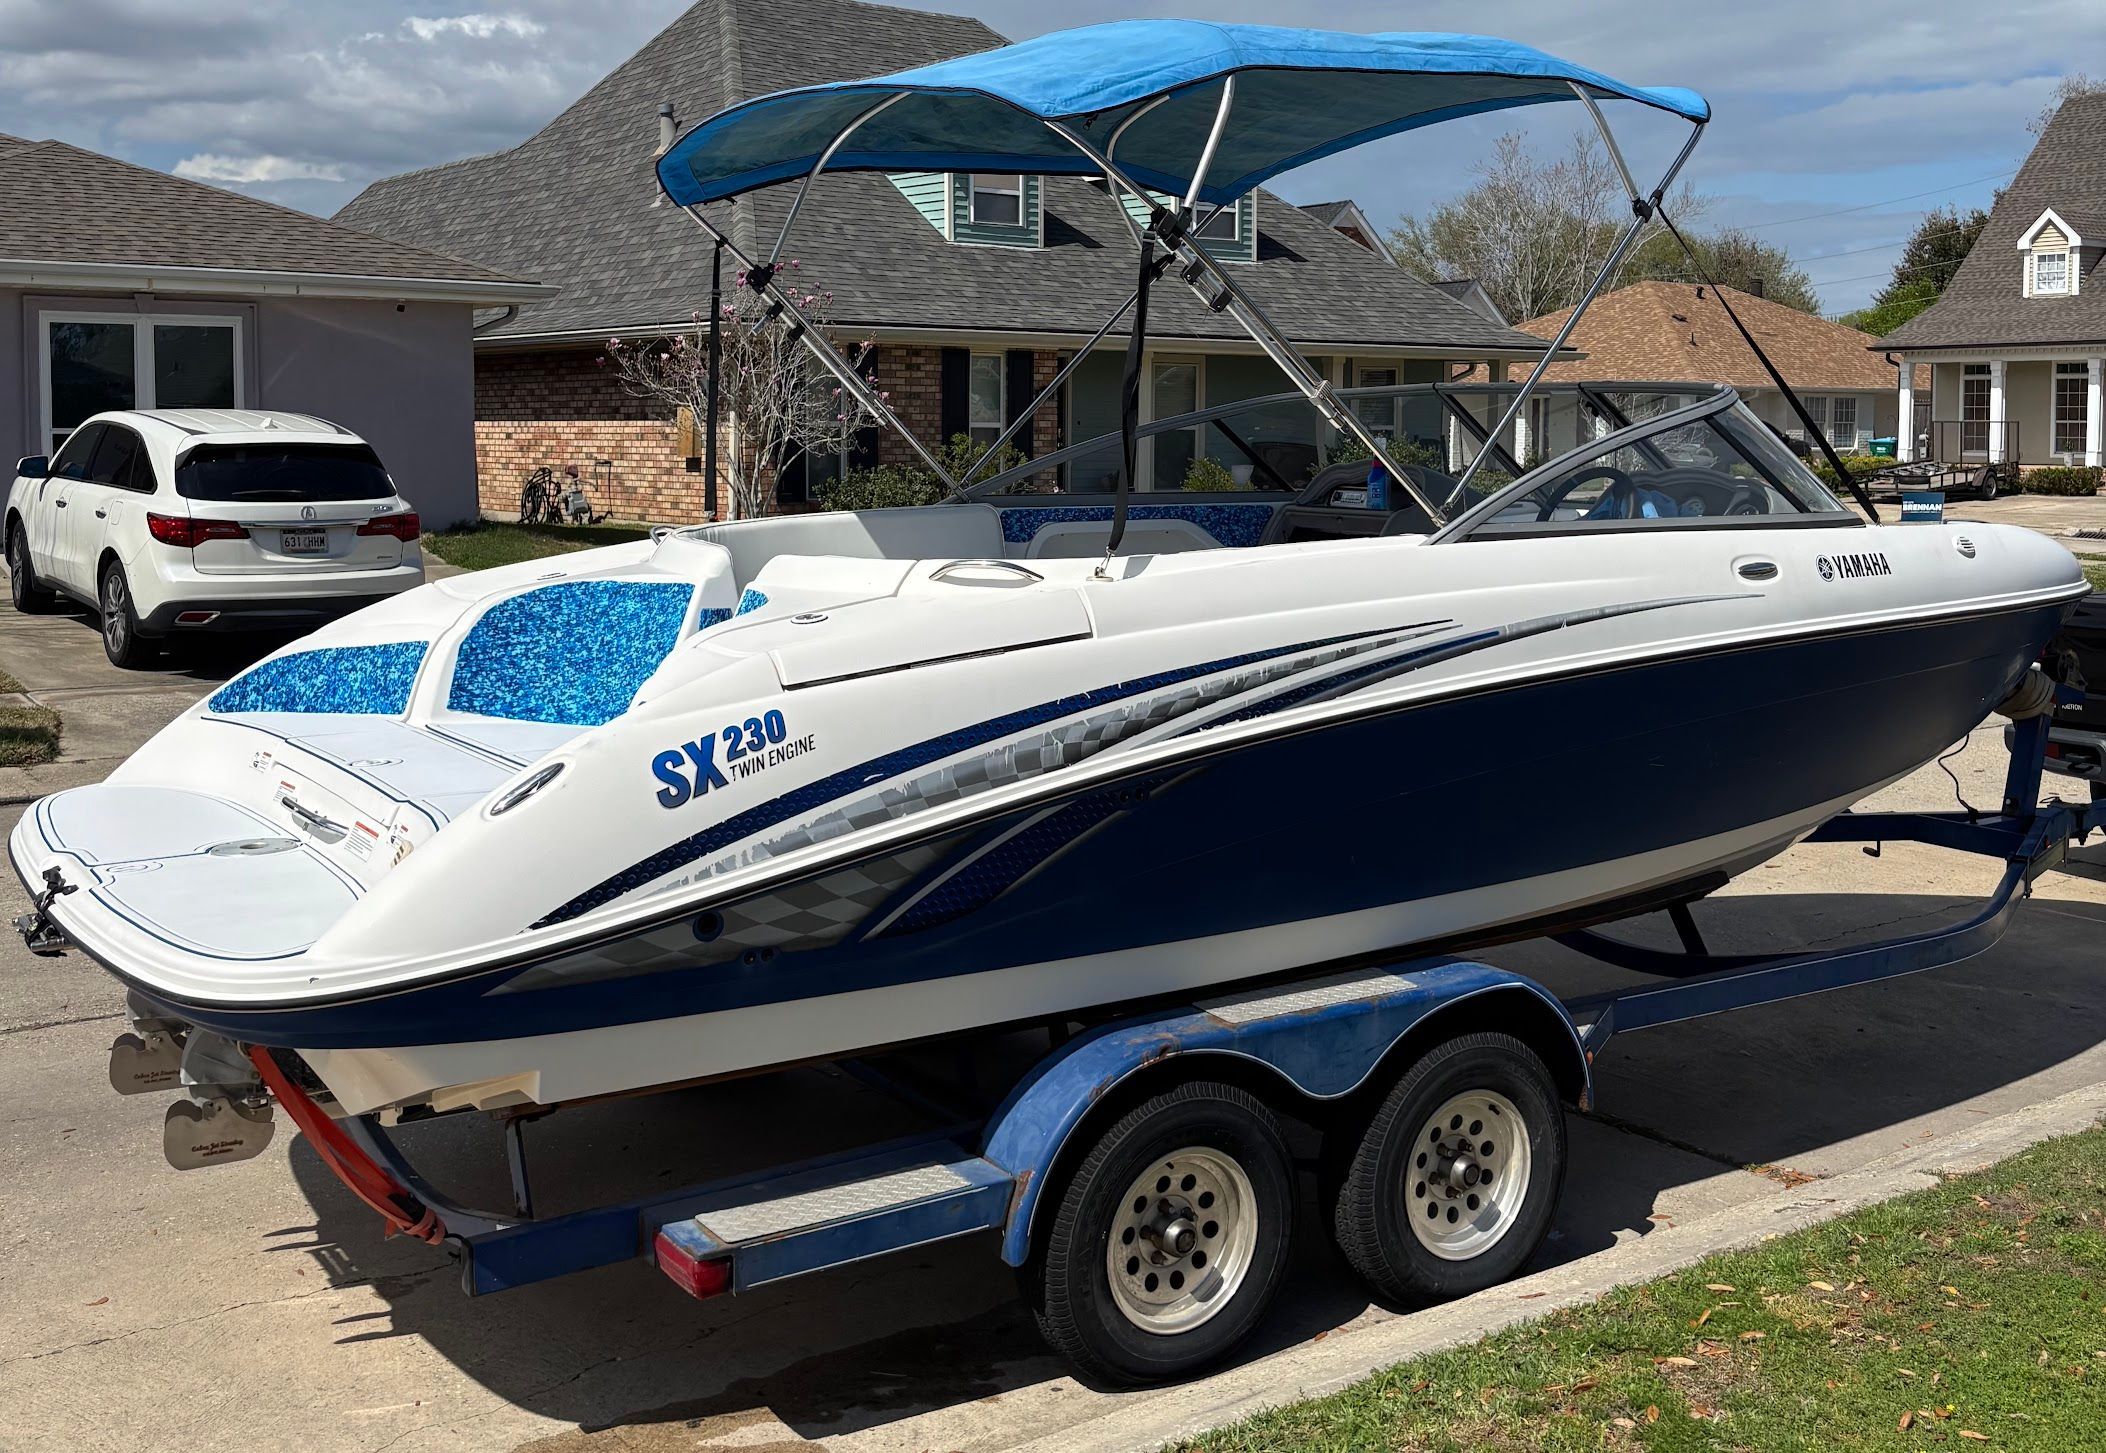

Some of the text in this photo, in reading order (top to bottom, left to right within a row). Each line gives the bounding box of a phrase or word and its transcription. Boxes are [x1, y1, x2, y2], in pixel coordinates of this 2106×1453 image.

[1902, 503, 1942, 511] BRENNAN
[284, 536, 301, 547] 631
[1831, 553, 1892, 578] YAMAHA
[652, 709, 787, 809] SX 230
[729, 734, 816, 781] TWIN ENGINE
